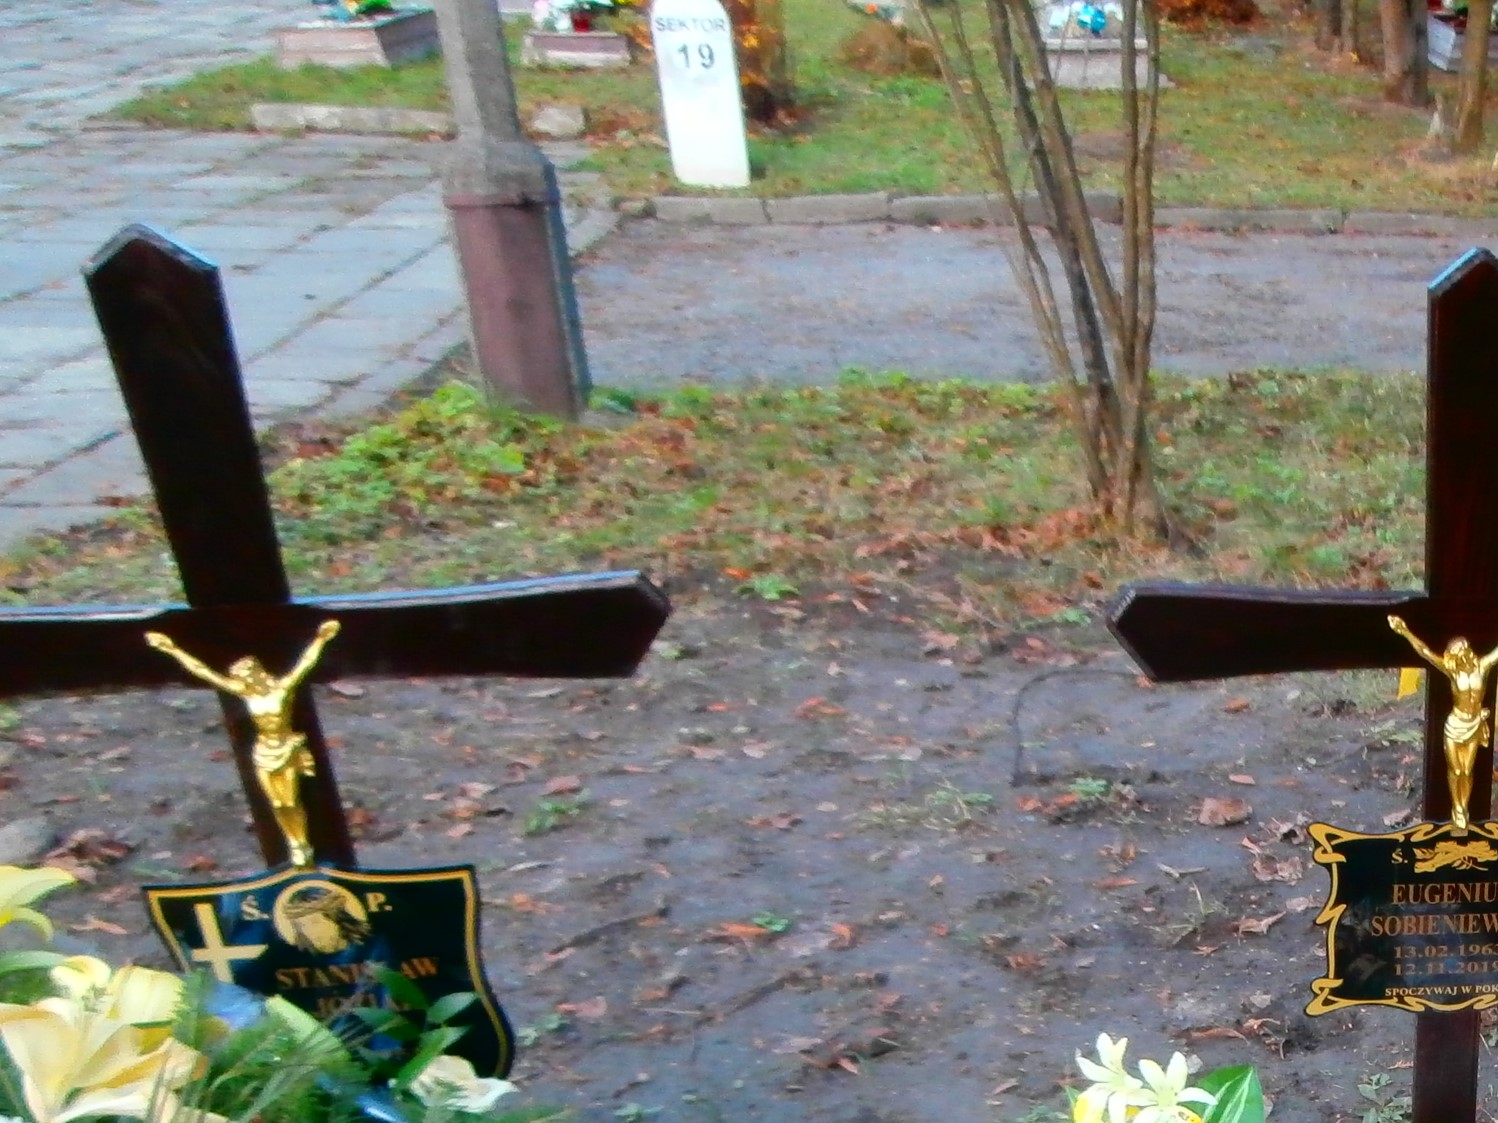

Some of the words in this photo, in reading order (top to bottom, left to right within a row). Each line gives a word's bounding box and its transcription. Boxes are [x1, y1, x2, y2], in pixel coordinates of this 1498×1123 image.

[655, 17, 727, 32] SEKTOR
[677, 43, 715, 69] 19
[366, 892, 393, 912] P.
[1385, 985, 1458, 997] SPOCZYWAJ
[1461, 985, 1473, 994] W
